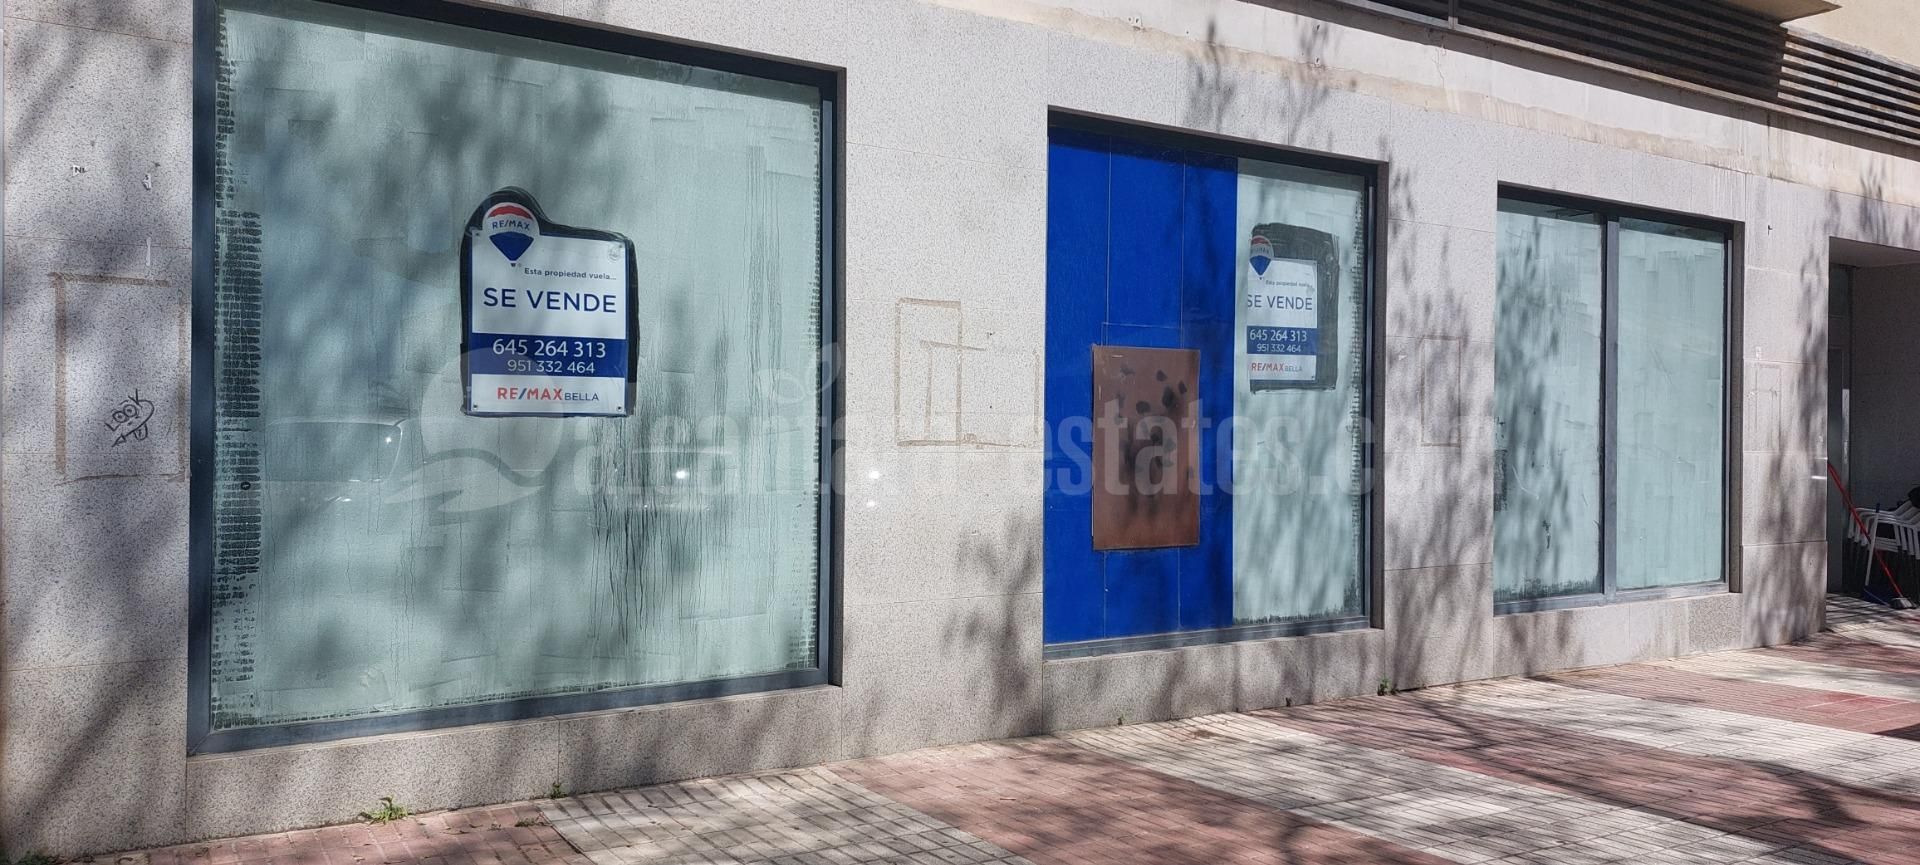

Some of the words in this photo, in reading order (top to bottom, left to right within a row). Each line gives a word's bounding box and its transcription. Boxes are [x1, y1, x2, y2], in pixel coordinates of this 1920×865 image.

[492, 220, 530, 231] RE/MAX
[524, 267, 542, 276] Esta
[544, 270, 587, 279] propiedad
[483, 287, 517, 308] SE
[526, 289, 617, 313] VENDE
[1266, 295, 1313, 310] VENDE
[1249, 329, 1268, 341] 645
[1270, 329, 1288, 341] 264
[1290, 330, 1307, 342] 313
[492, 338, 528, 356] 645
[534, 340, 569, 358] 264
[573, 341, 606, 358] 313
[1256, 343, 1269, 352] 951
[1271, 344, 1285, 352] 332
[507, 359, 531, 372] 951
[536, 360, 562, 374] 332
[567, 361, 596, 374] 464
[1251, 362, 1284, 372] RE/MAX
[497, 387, 563, 401] RE/MAX
[564, 392, 599, 401] BELLA
